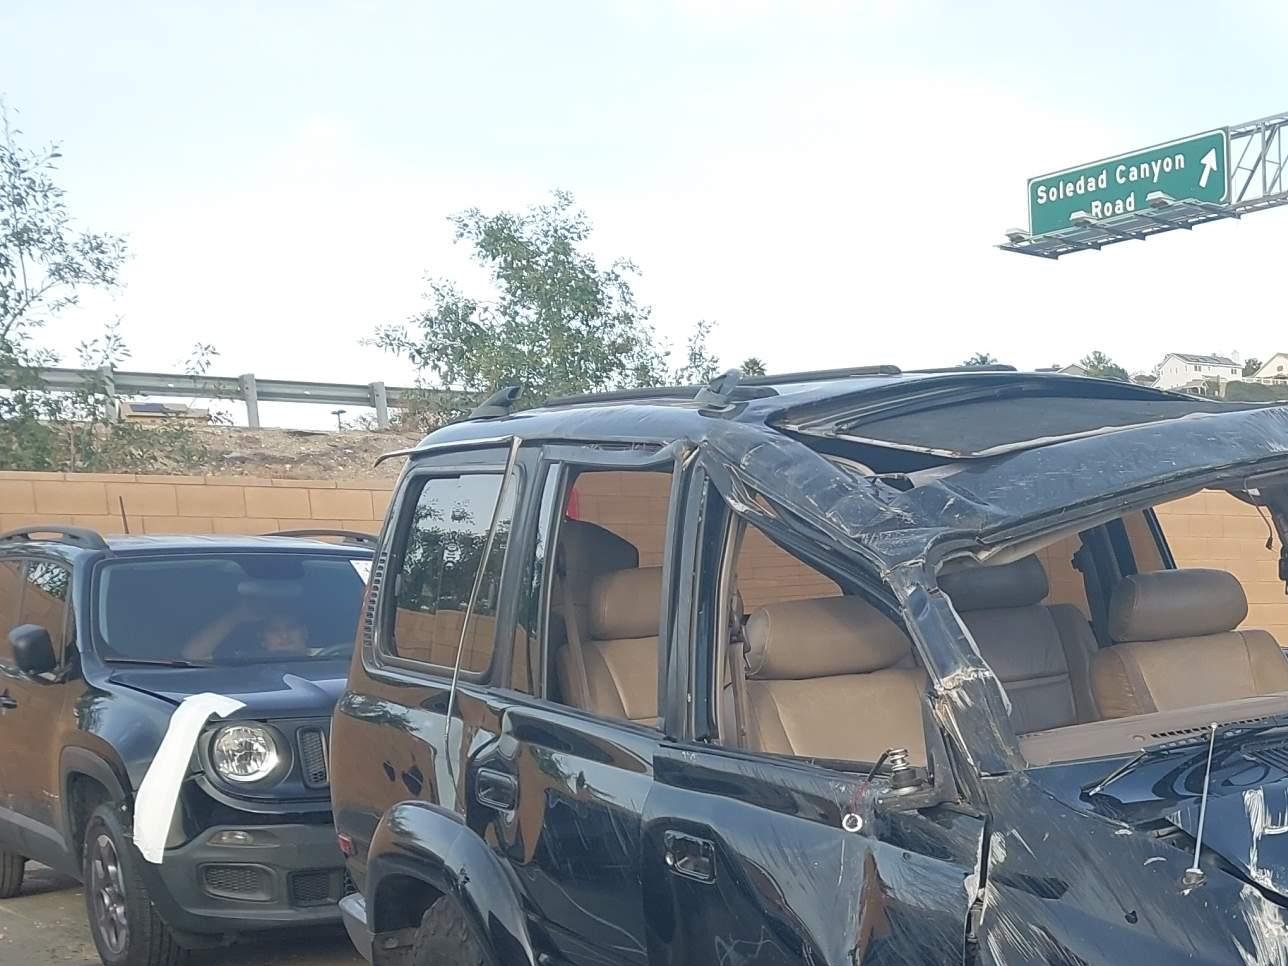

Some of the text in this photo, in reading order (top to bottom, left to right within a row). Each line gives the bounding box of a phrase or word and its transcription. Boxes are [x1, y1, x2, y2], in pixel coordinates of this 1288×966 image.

[1036, 153, 1185, 204] Soledad Canyon
[1091, 192, 1135, 219] Road
